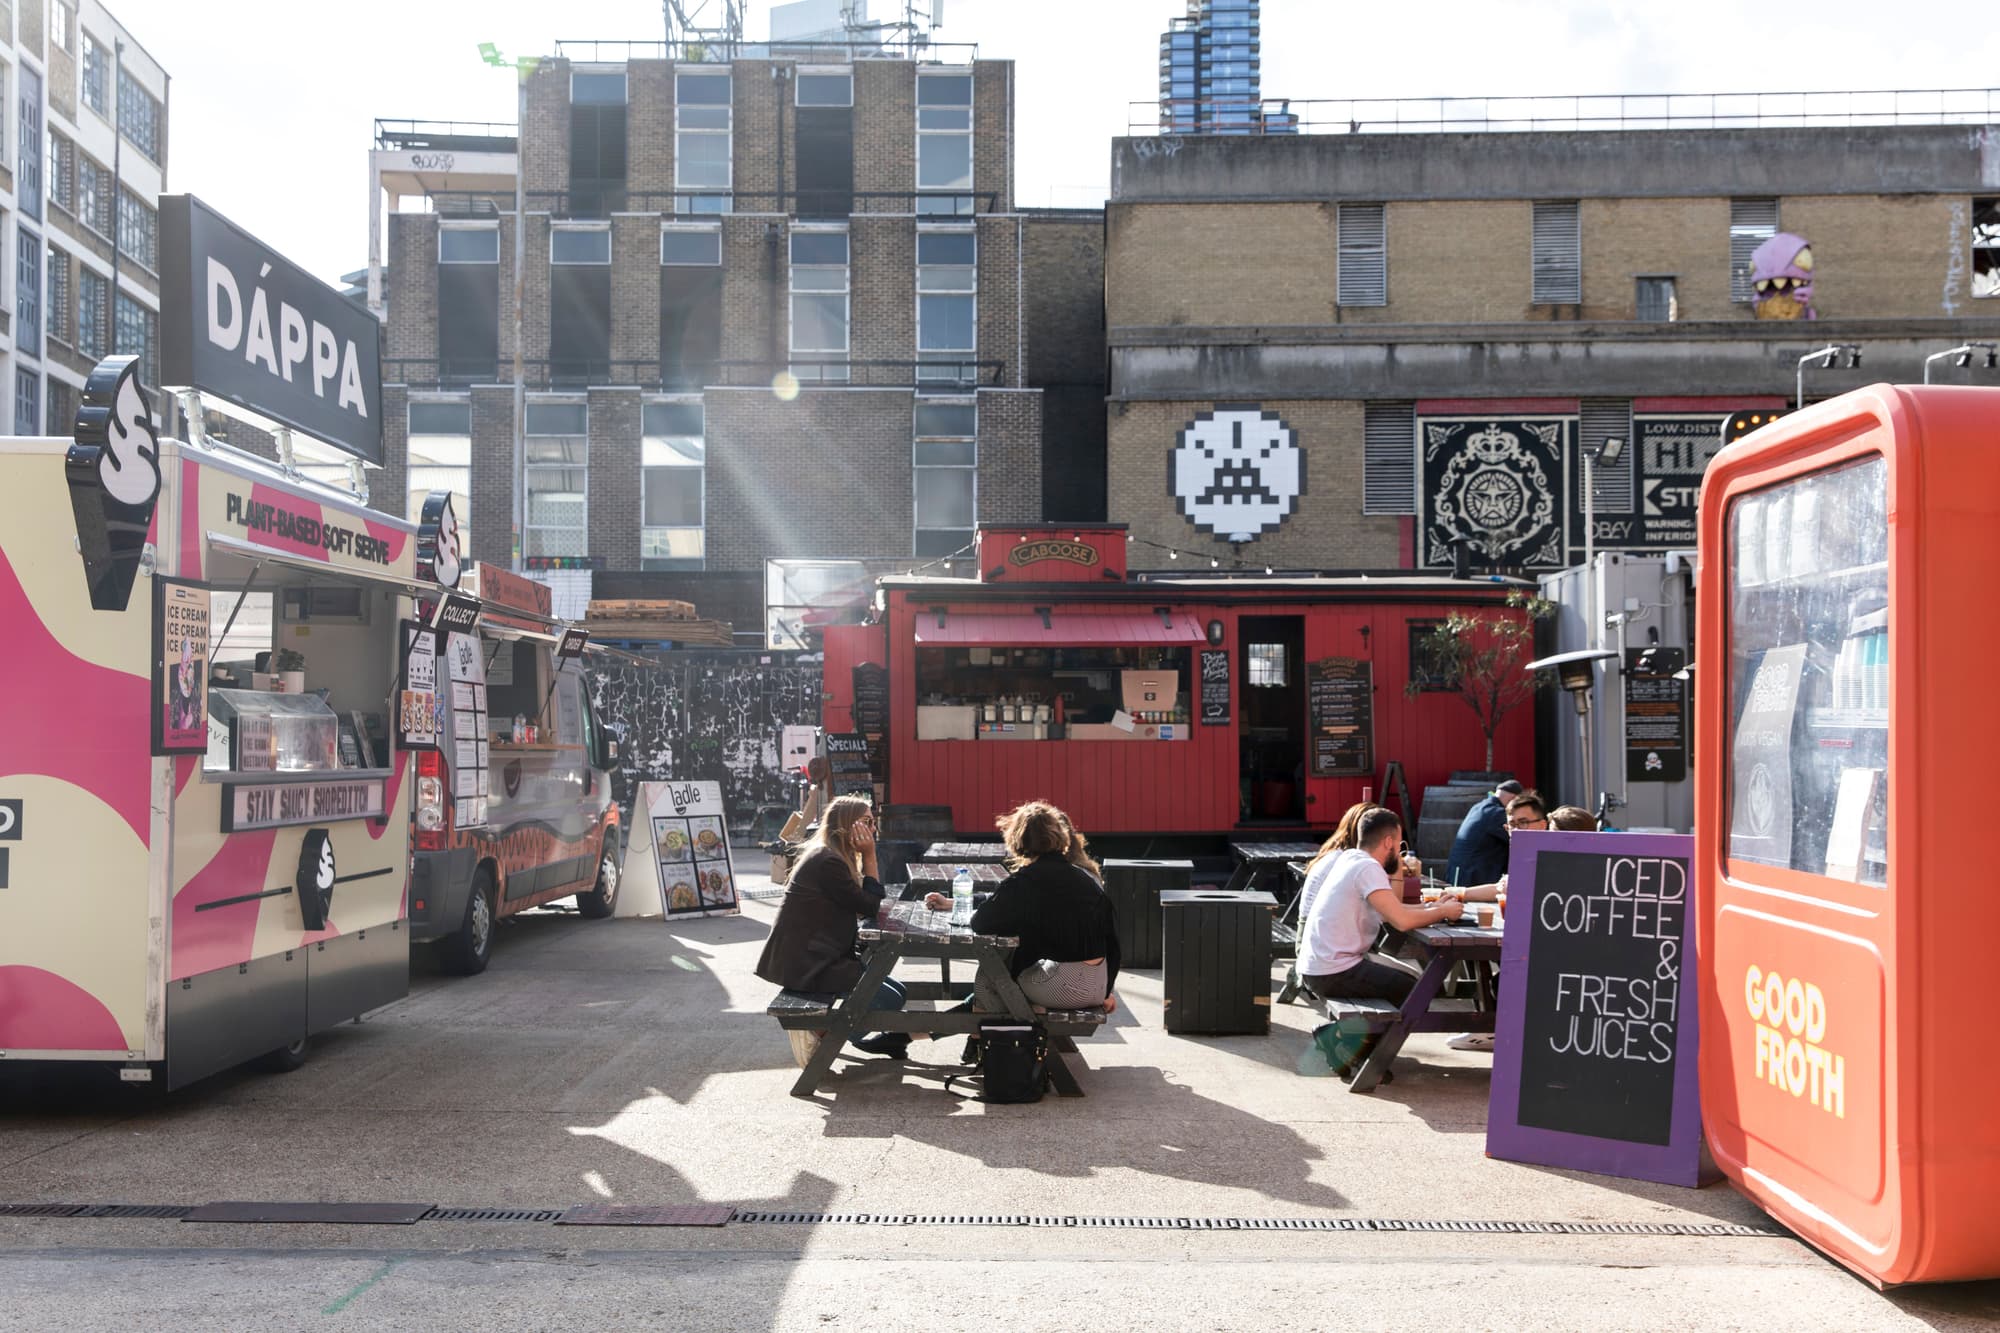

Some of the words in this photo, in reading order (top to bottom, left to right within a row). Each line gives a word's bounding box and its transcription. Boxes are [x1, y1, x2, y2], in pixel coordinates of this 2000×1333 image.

[207, 256, 368, 418] DÁPPA
[1645, 424, 1721, 434] LOW-DIST
[227, 493, 321, 546] PLANT-BASED
[322, 523, 354, 555] SOFT
[355, 533, 389, 565] SERVE
[1018, 543, 1088, 561] CABOOSE
[167, 604, 179, 619] ICE
[181, 607, 207, 623] CREAM
[167, 621, 179, 636] ICE
[181, 624, 207, 640] CREAM
[443, 605, 476, 625] COLLECT
[166, 639, 179, 653] ICE
[181, 640, 206, 656] EAM
[247, 790, 275, 823] STAY
[280, 788, 310, 820] SAUCY
[313, 785, 369, 817] SHOREDITCH
[667, 783, 701, 807] ladle
[1603, 857, 1686, 900] ICED
[1540, 892, 1684, 940] COFFEE
[1656, 940, 1679, 981] &
[1556, 973, 1678, 1022] FRESH
[1744, 964, 1827, 1045] GOOD
[1550, 1015, 1673, 1063] JUICES
[1755, 1022, 1846, 1120] FROTH
